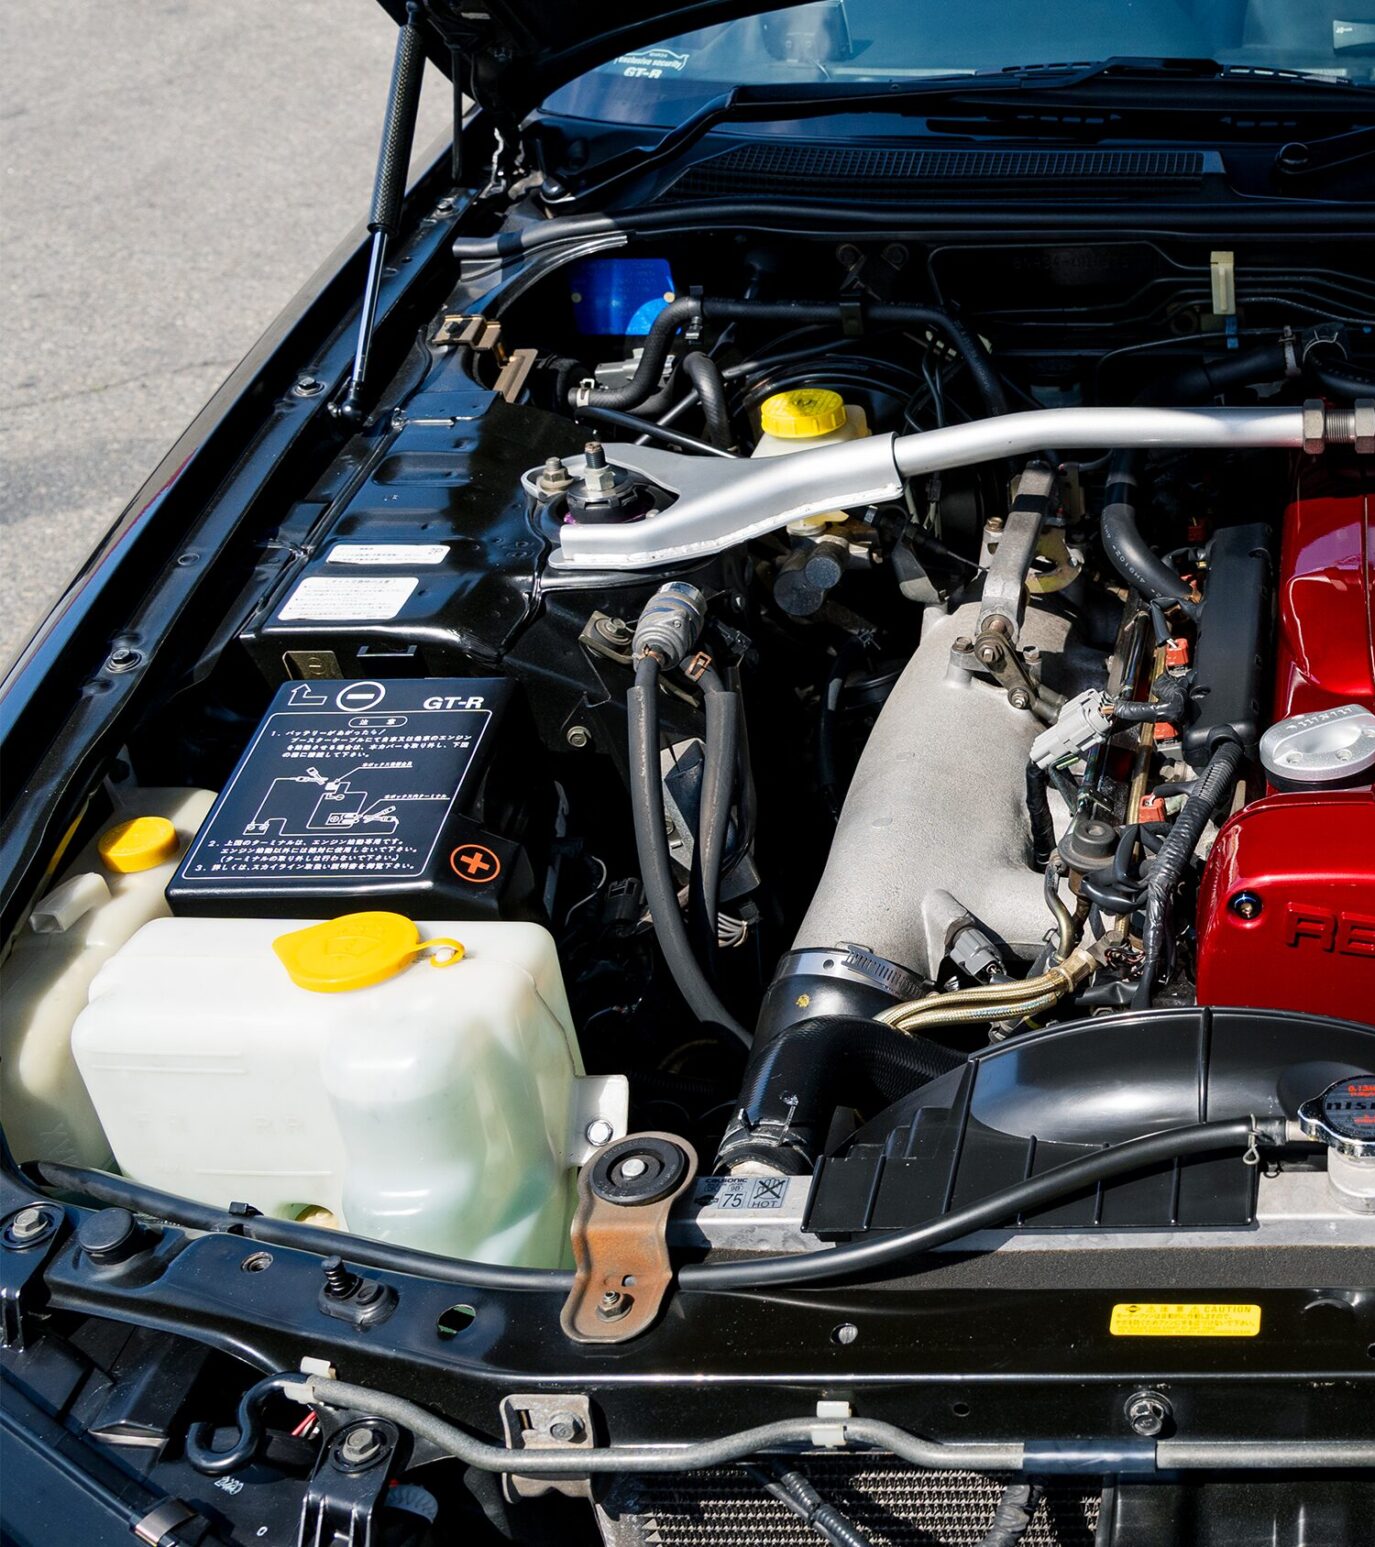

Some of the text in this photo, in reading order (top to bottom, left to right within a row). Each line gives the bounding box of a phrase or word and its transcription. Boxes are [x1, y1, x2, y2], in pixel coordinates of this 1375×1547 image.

[623, 67, 663, 79] GT-R
[423, 696, 485, 710] GT-R
[722, 1194, 743, 1208] 75
